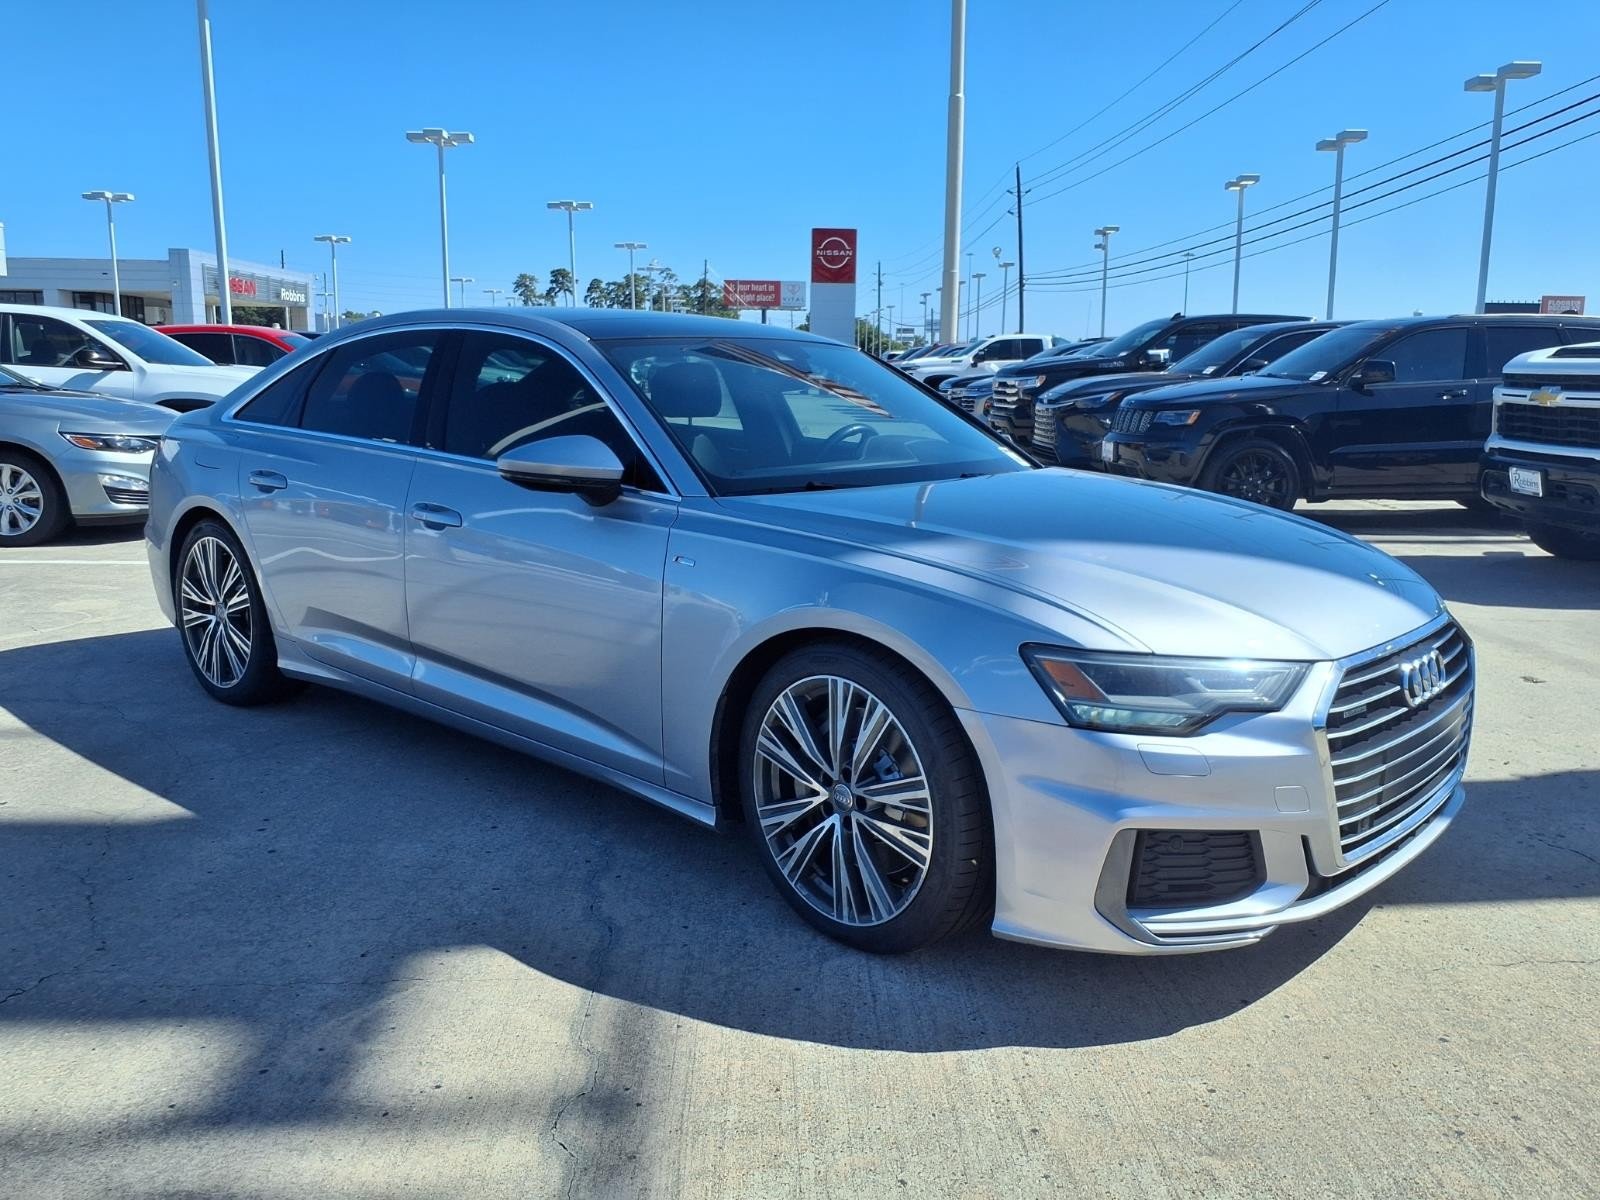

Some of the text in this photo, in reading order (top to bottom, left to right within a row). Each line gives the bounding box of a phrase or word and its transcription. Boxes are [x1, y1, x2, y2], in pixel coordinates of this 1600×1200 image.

[229, 277, 256, 297] SSAN
[751, 283, 767, 292] heart
[768, 284, 775, 292] in
[280, 288, 305, 303] Robbins
[756, 293, 775, 302] place?
[1513, 472, 1540, 489] Robbins
